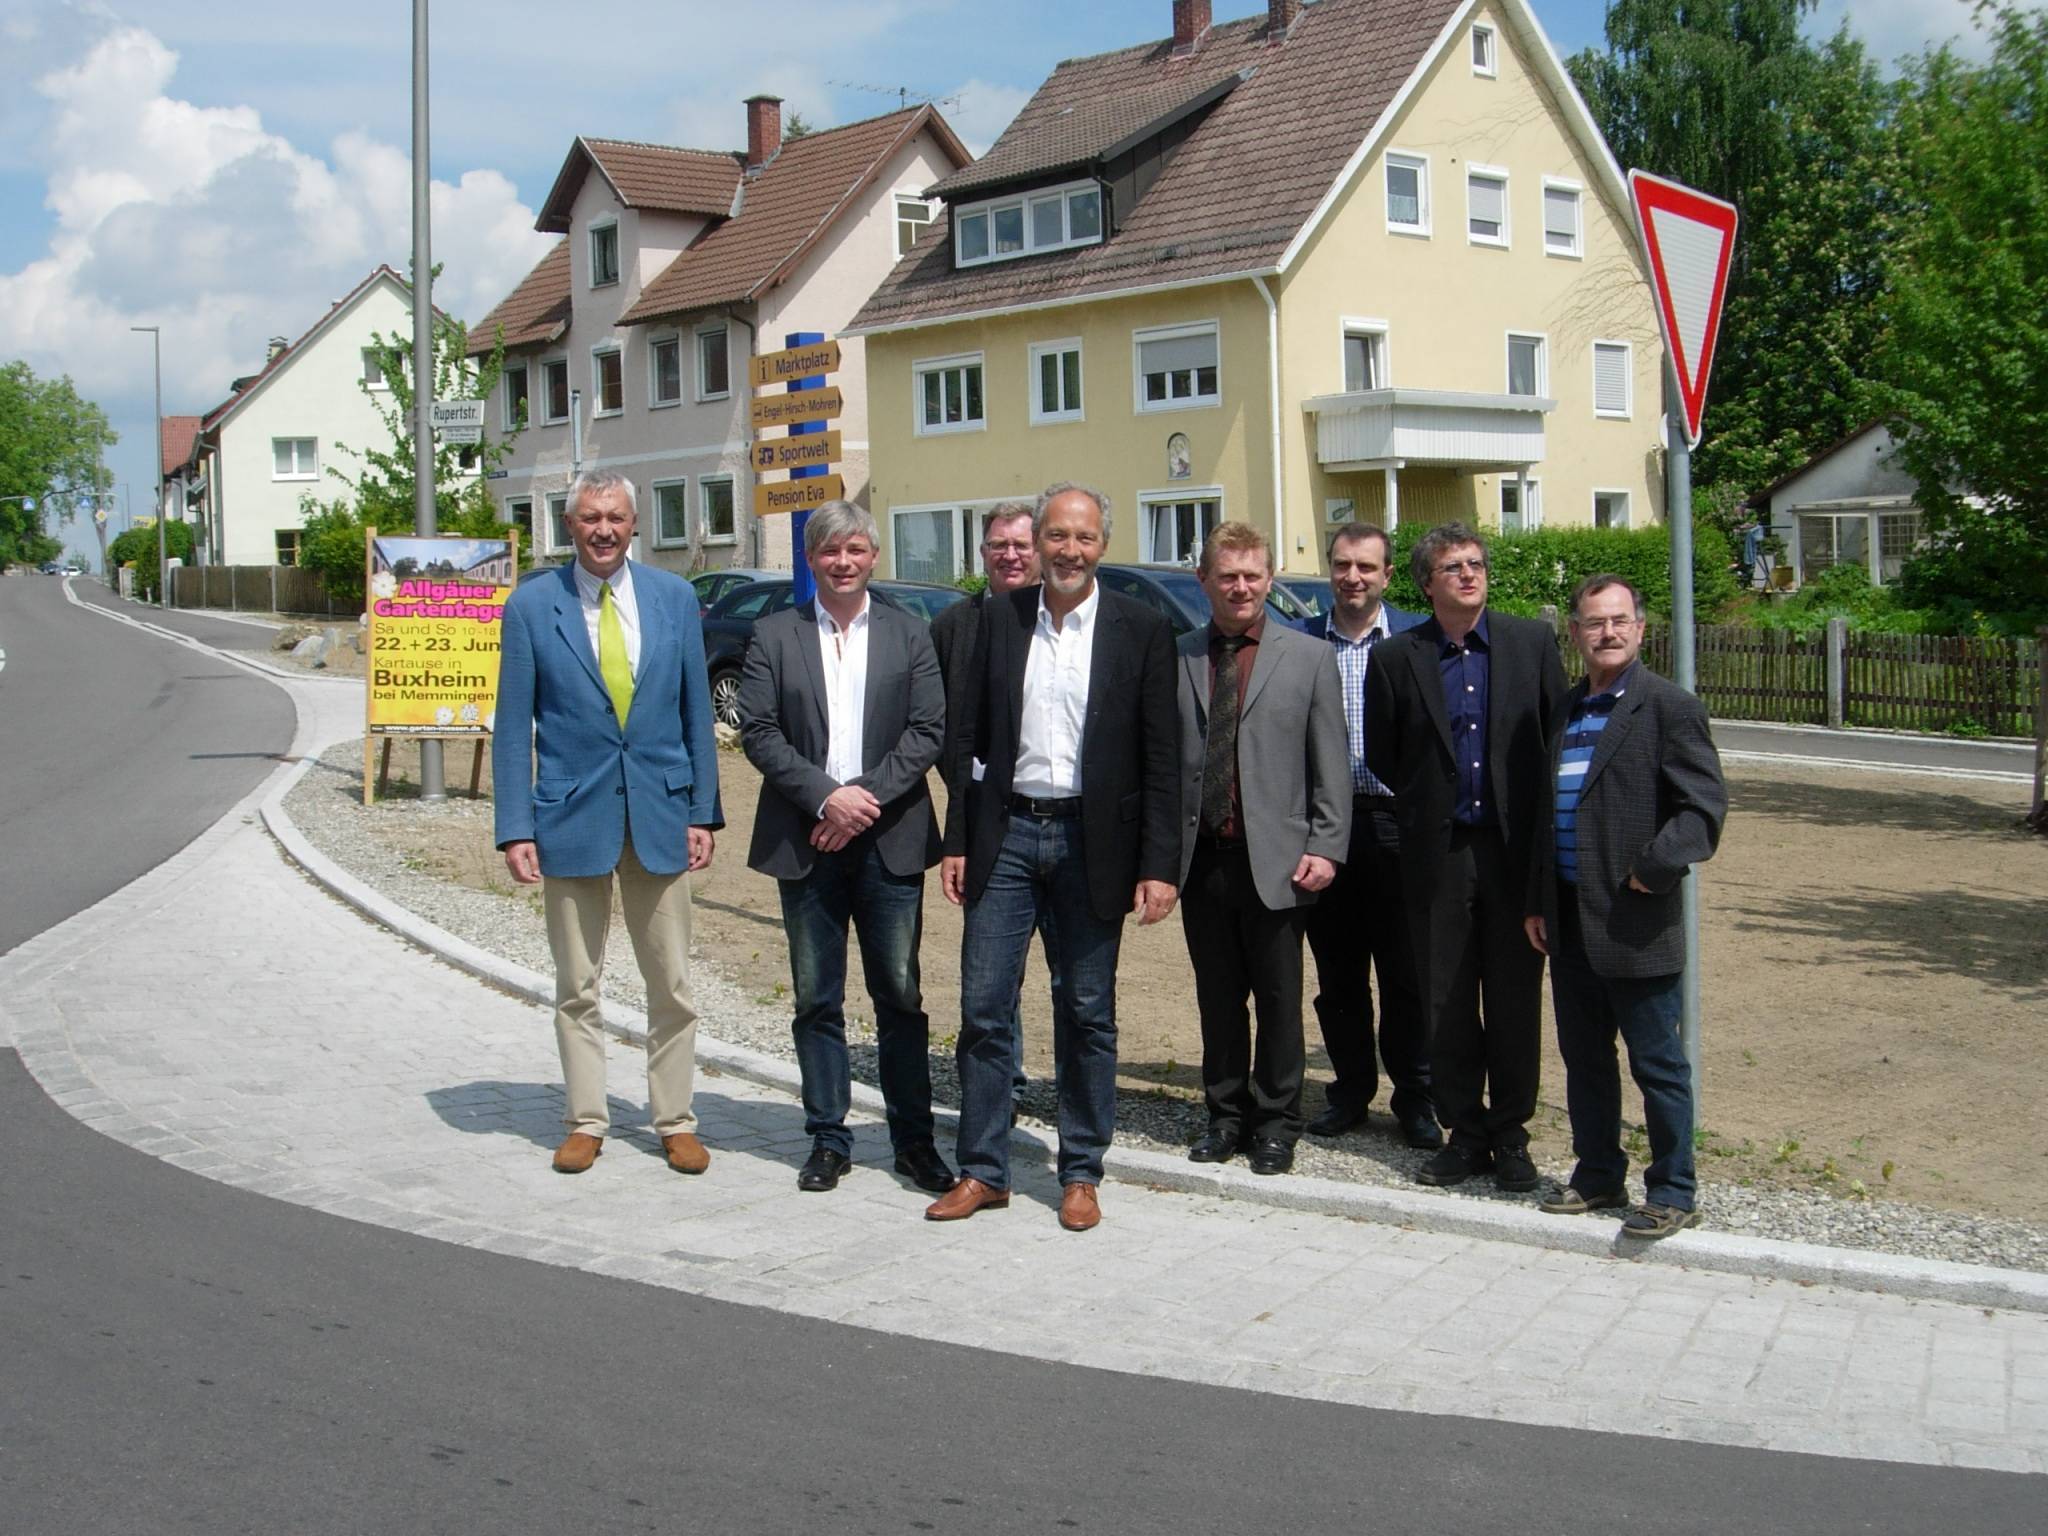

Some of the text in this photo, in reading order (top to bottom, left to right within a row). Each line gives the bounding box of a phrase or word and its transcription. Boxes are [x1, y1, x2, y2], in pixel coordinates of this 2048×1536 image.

[775, 352, 830, 376] Marktplatz
[433, 405, 478, 423] Rupertstr.
[763, 398, 837, 420] Engel-Hirsch-Mohren
[779, 441, 830, 465] Sportwelt
[767, 485, 825, 507] Pension Eva
[397, 579, 497, 602] Allgäuer
[373, 598, 504, 624] Gartentage
[375, 623, 394, 635] Sa
[400, 623, 430, 636] und
[436, 623, 457, 636] So
[374, 657, 462, 670] Kartause in
[373, 669, 487, 688] Buxheim
[373, 689, 495, 703] bei Memmingen
